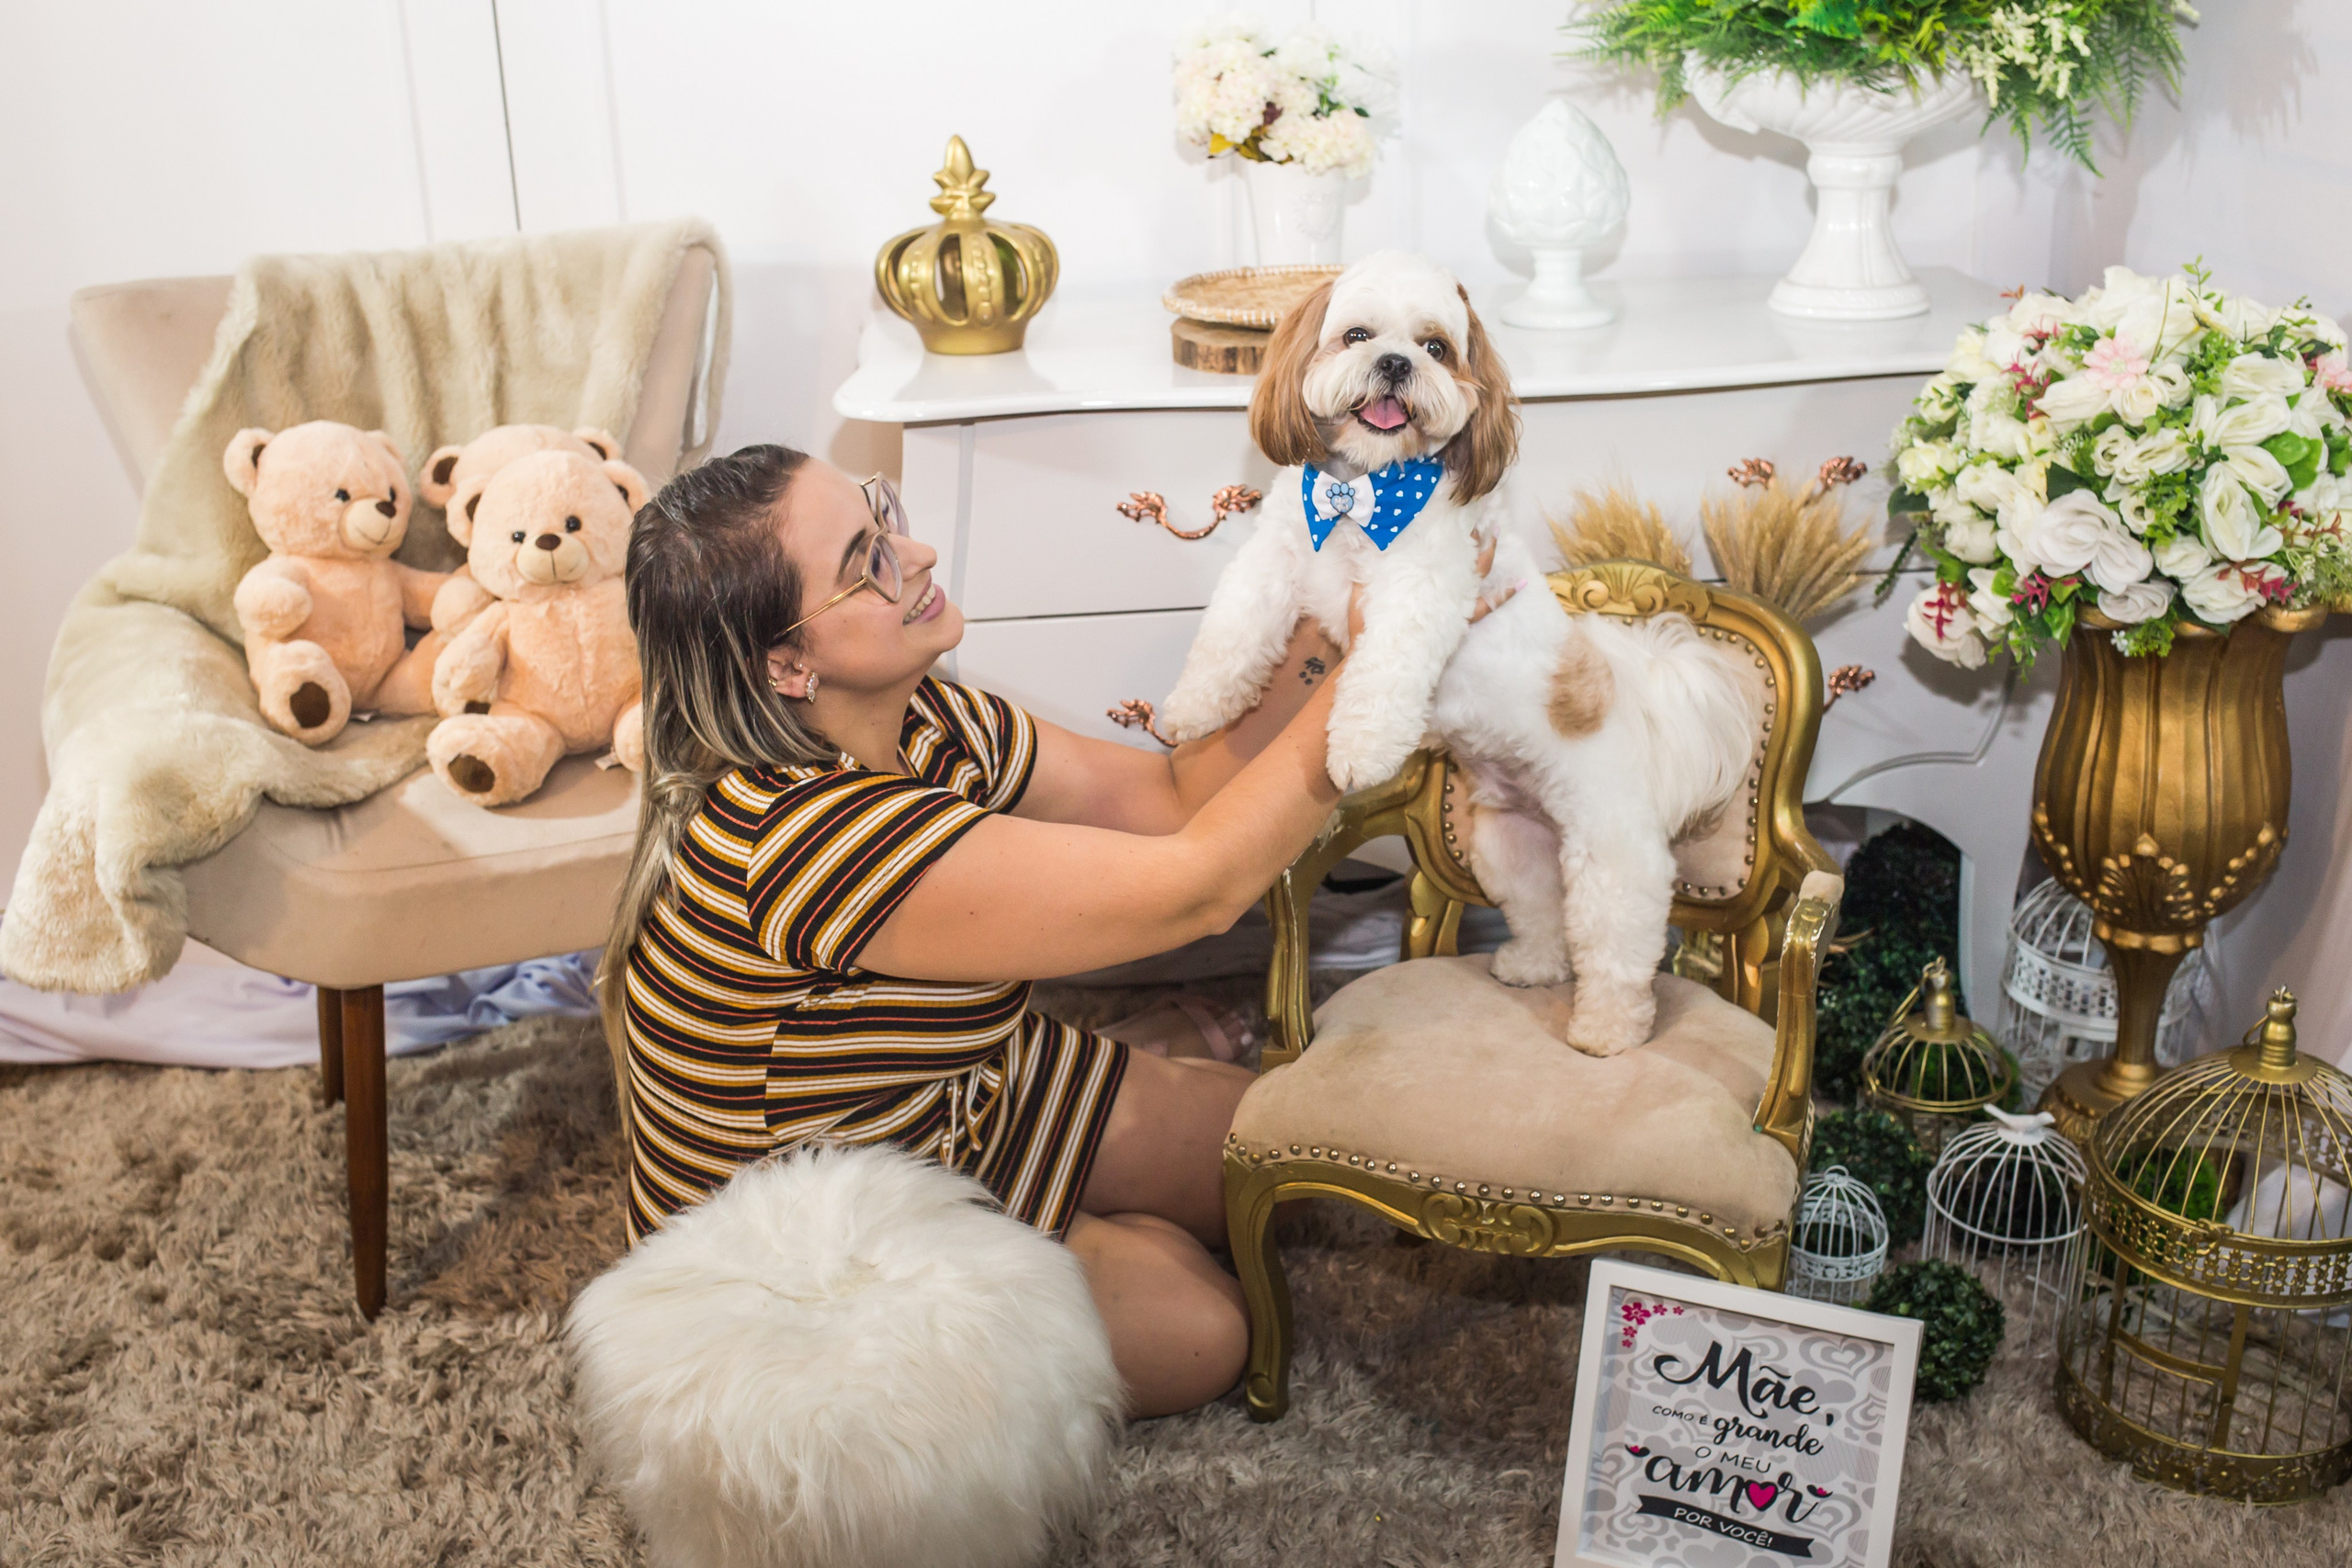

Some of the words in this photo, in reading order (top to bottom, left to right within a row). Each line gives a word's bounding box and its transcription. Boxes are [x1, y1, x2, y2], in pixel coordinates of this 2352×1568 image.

[1654, 1340, 1834, 1427] Mãe,
[1652, 1405, 1695, 1421] COMO
[1699, 1415, 1709, 1425] É
[1713, 1416, 1824, 1456] grande
[1694, 1446, 1712, 1459] O
[1720, 1451, 1771, 1473] MEU
[1645, 1455, 1819, 1523] amor
[1673, 1507, 1713, 1529] POR
[1719, 1521, 1773, 1548] VOCÊ!
